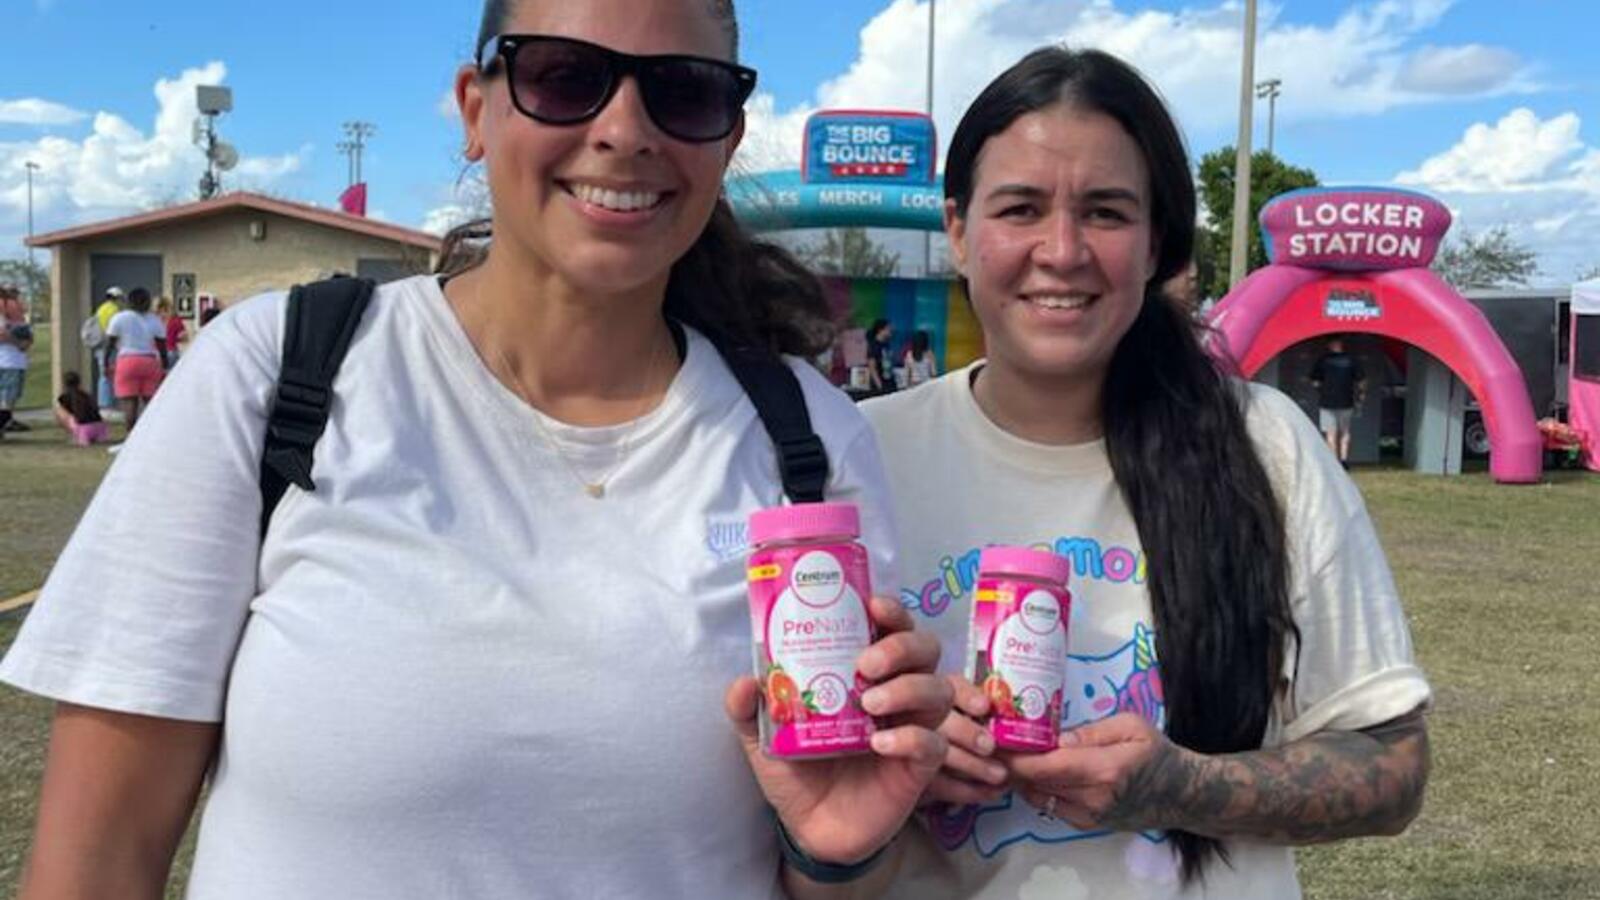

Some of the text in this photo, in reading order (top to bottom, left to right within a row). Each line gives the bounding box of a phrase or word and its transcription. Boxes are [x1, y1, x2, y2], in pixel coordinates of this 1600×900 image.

[852, 126, 891, 144] BIG
[822, 145, 916, 164] BOUNCE
[819, 190, 882, 205] MERCH
[1296, 203, 1424, 228] LOCKER
[1289, 232, 1421, 258] STATION
[795, 570, 840, 581] Centrum
